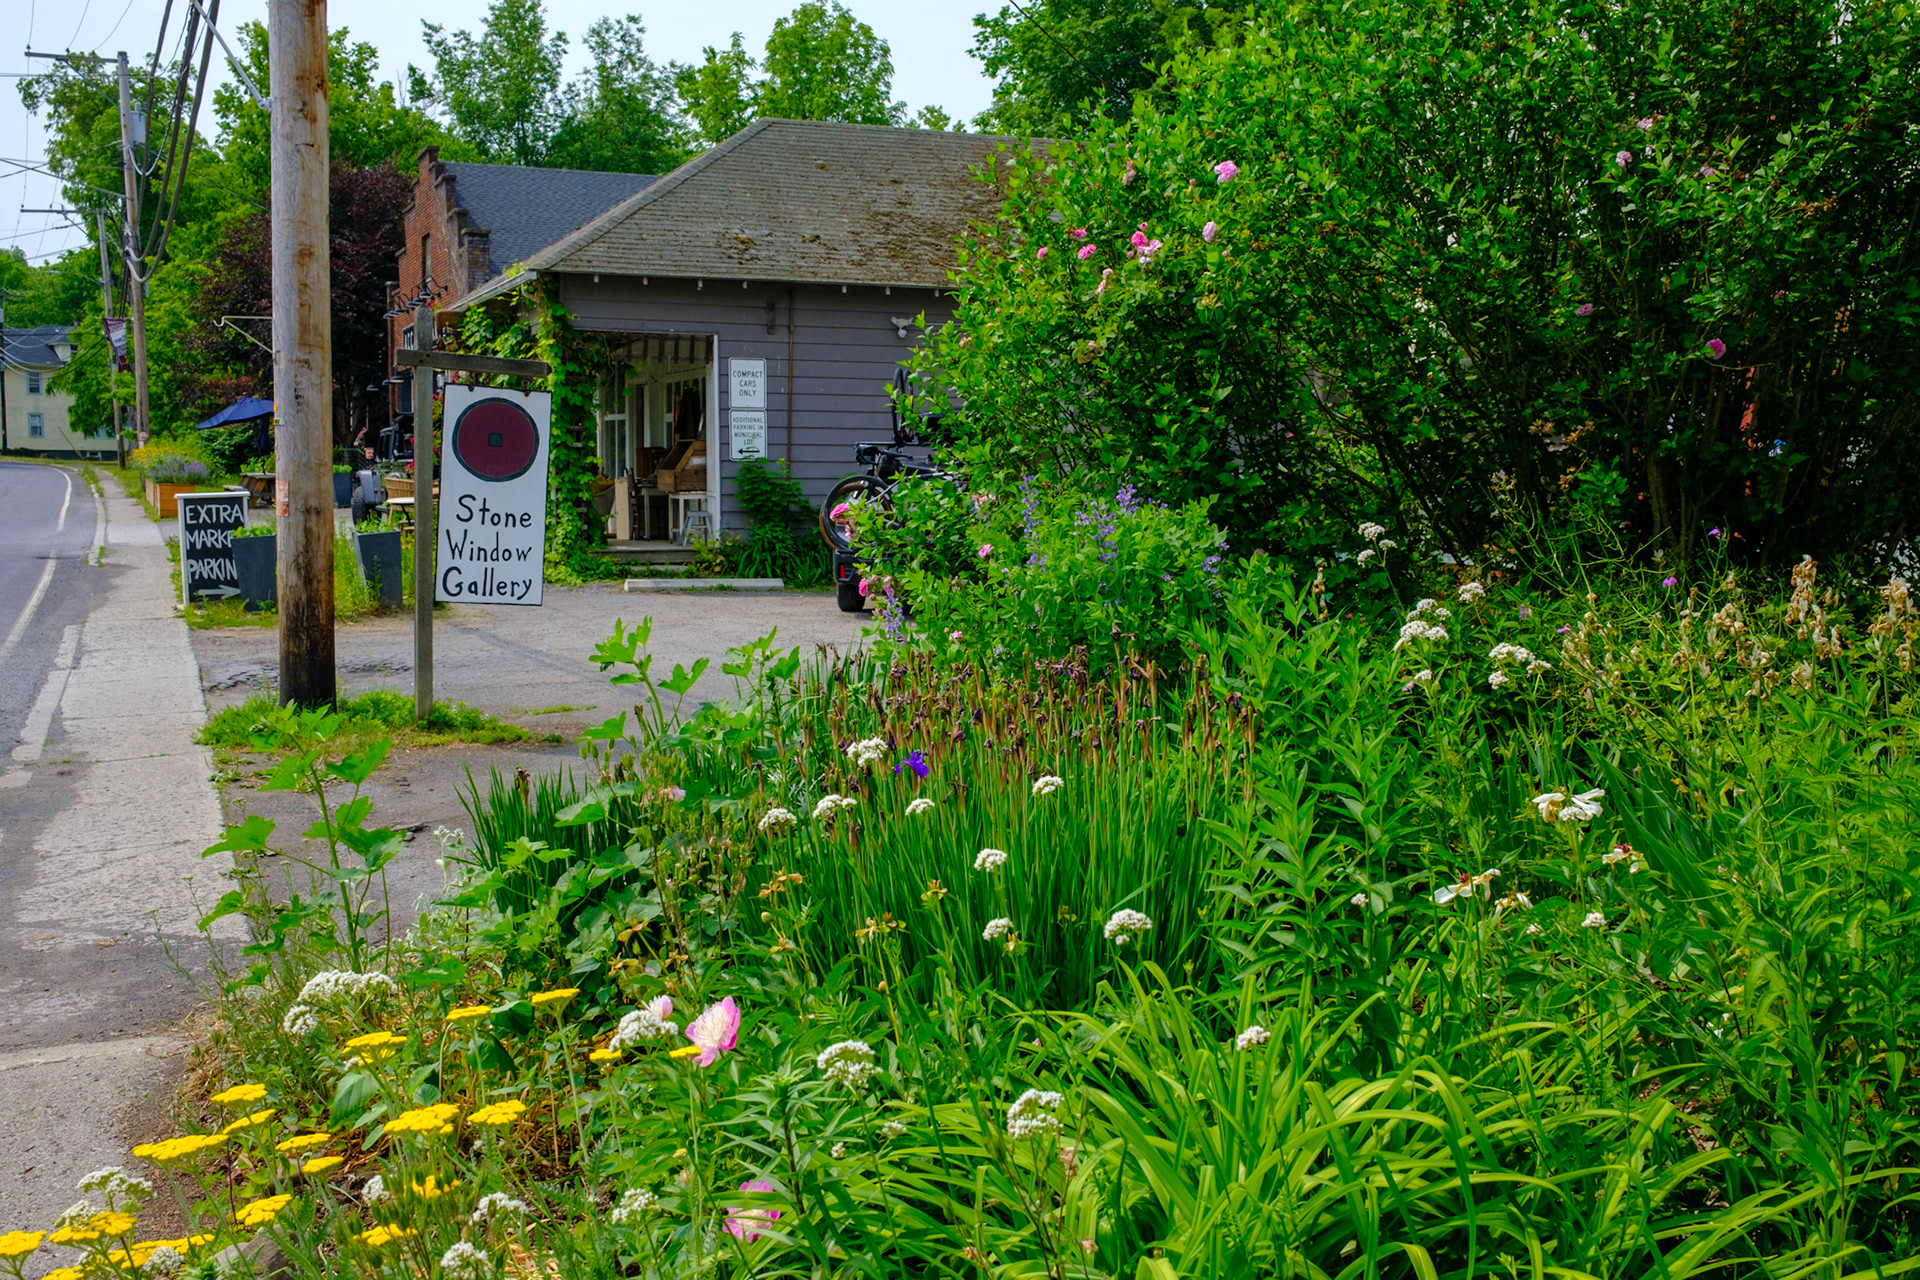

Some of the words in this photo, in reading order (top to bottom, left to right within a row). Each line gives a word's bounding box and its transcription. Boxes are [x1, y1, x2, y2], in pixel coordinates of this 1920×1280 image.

[186, 504, 244, 524] EXTRA
[456, 494, 532, 528] Stone
[446, 529, 532, 563] Window
[442, 566, 532, 600] Gallery
